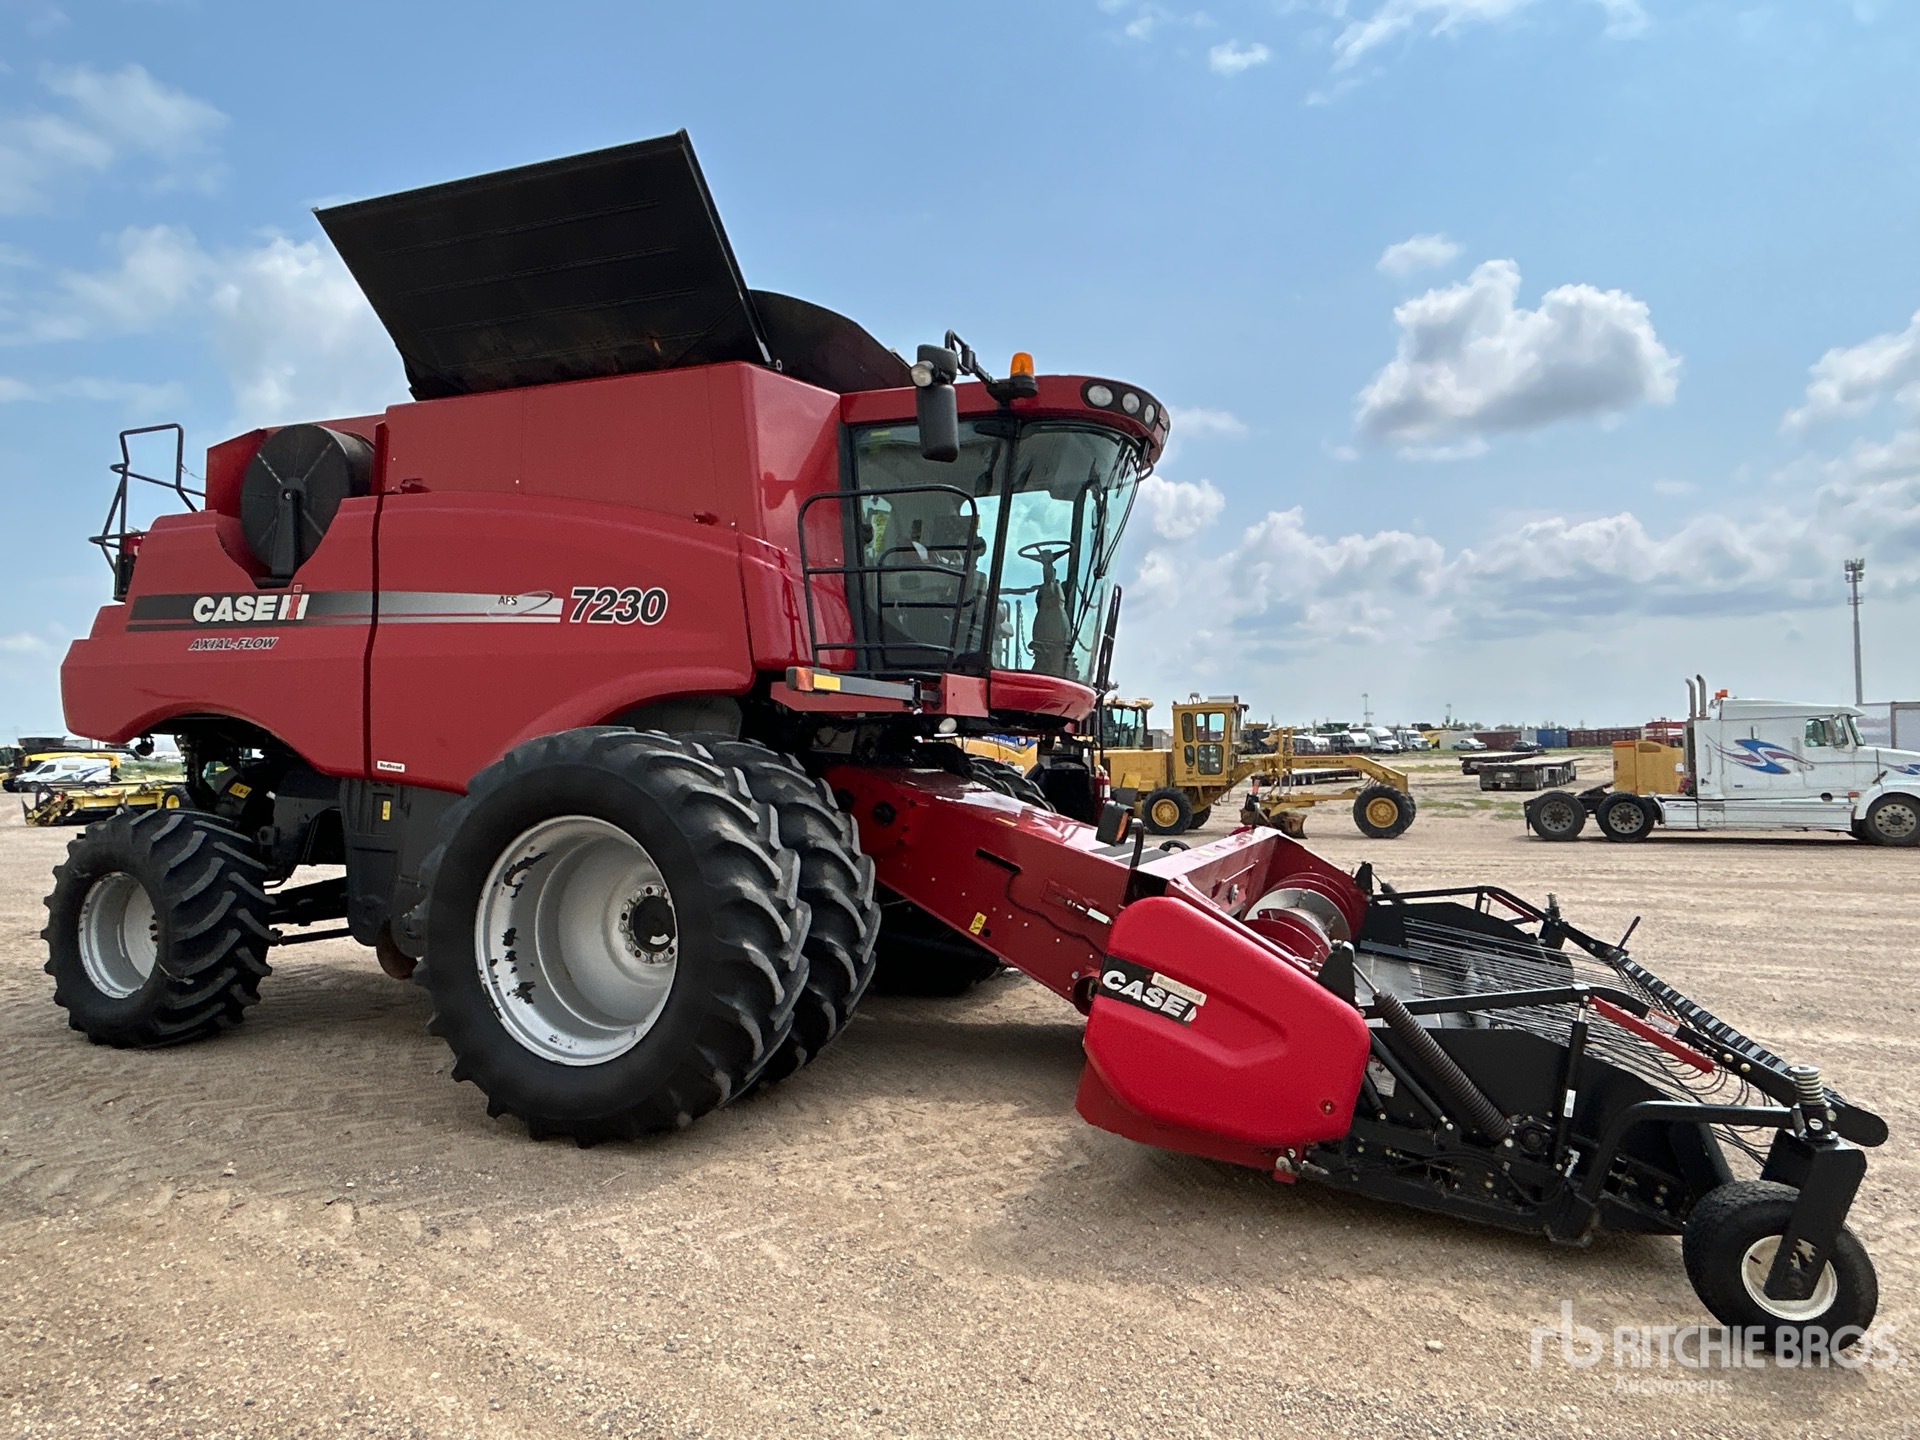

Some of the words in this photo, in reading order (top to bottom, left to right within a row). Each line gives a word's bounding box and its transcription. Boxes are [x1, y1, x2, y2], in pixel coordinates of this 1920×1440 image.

[193, 594, 277, 622] CASE
[498, 595, 518, 606] AFS
[569, 586, 668, 625] 7230
[188, 637, 279, 651] AXIAL-FLOW
[1102, 970, 1189, 1018] CASE
